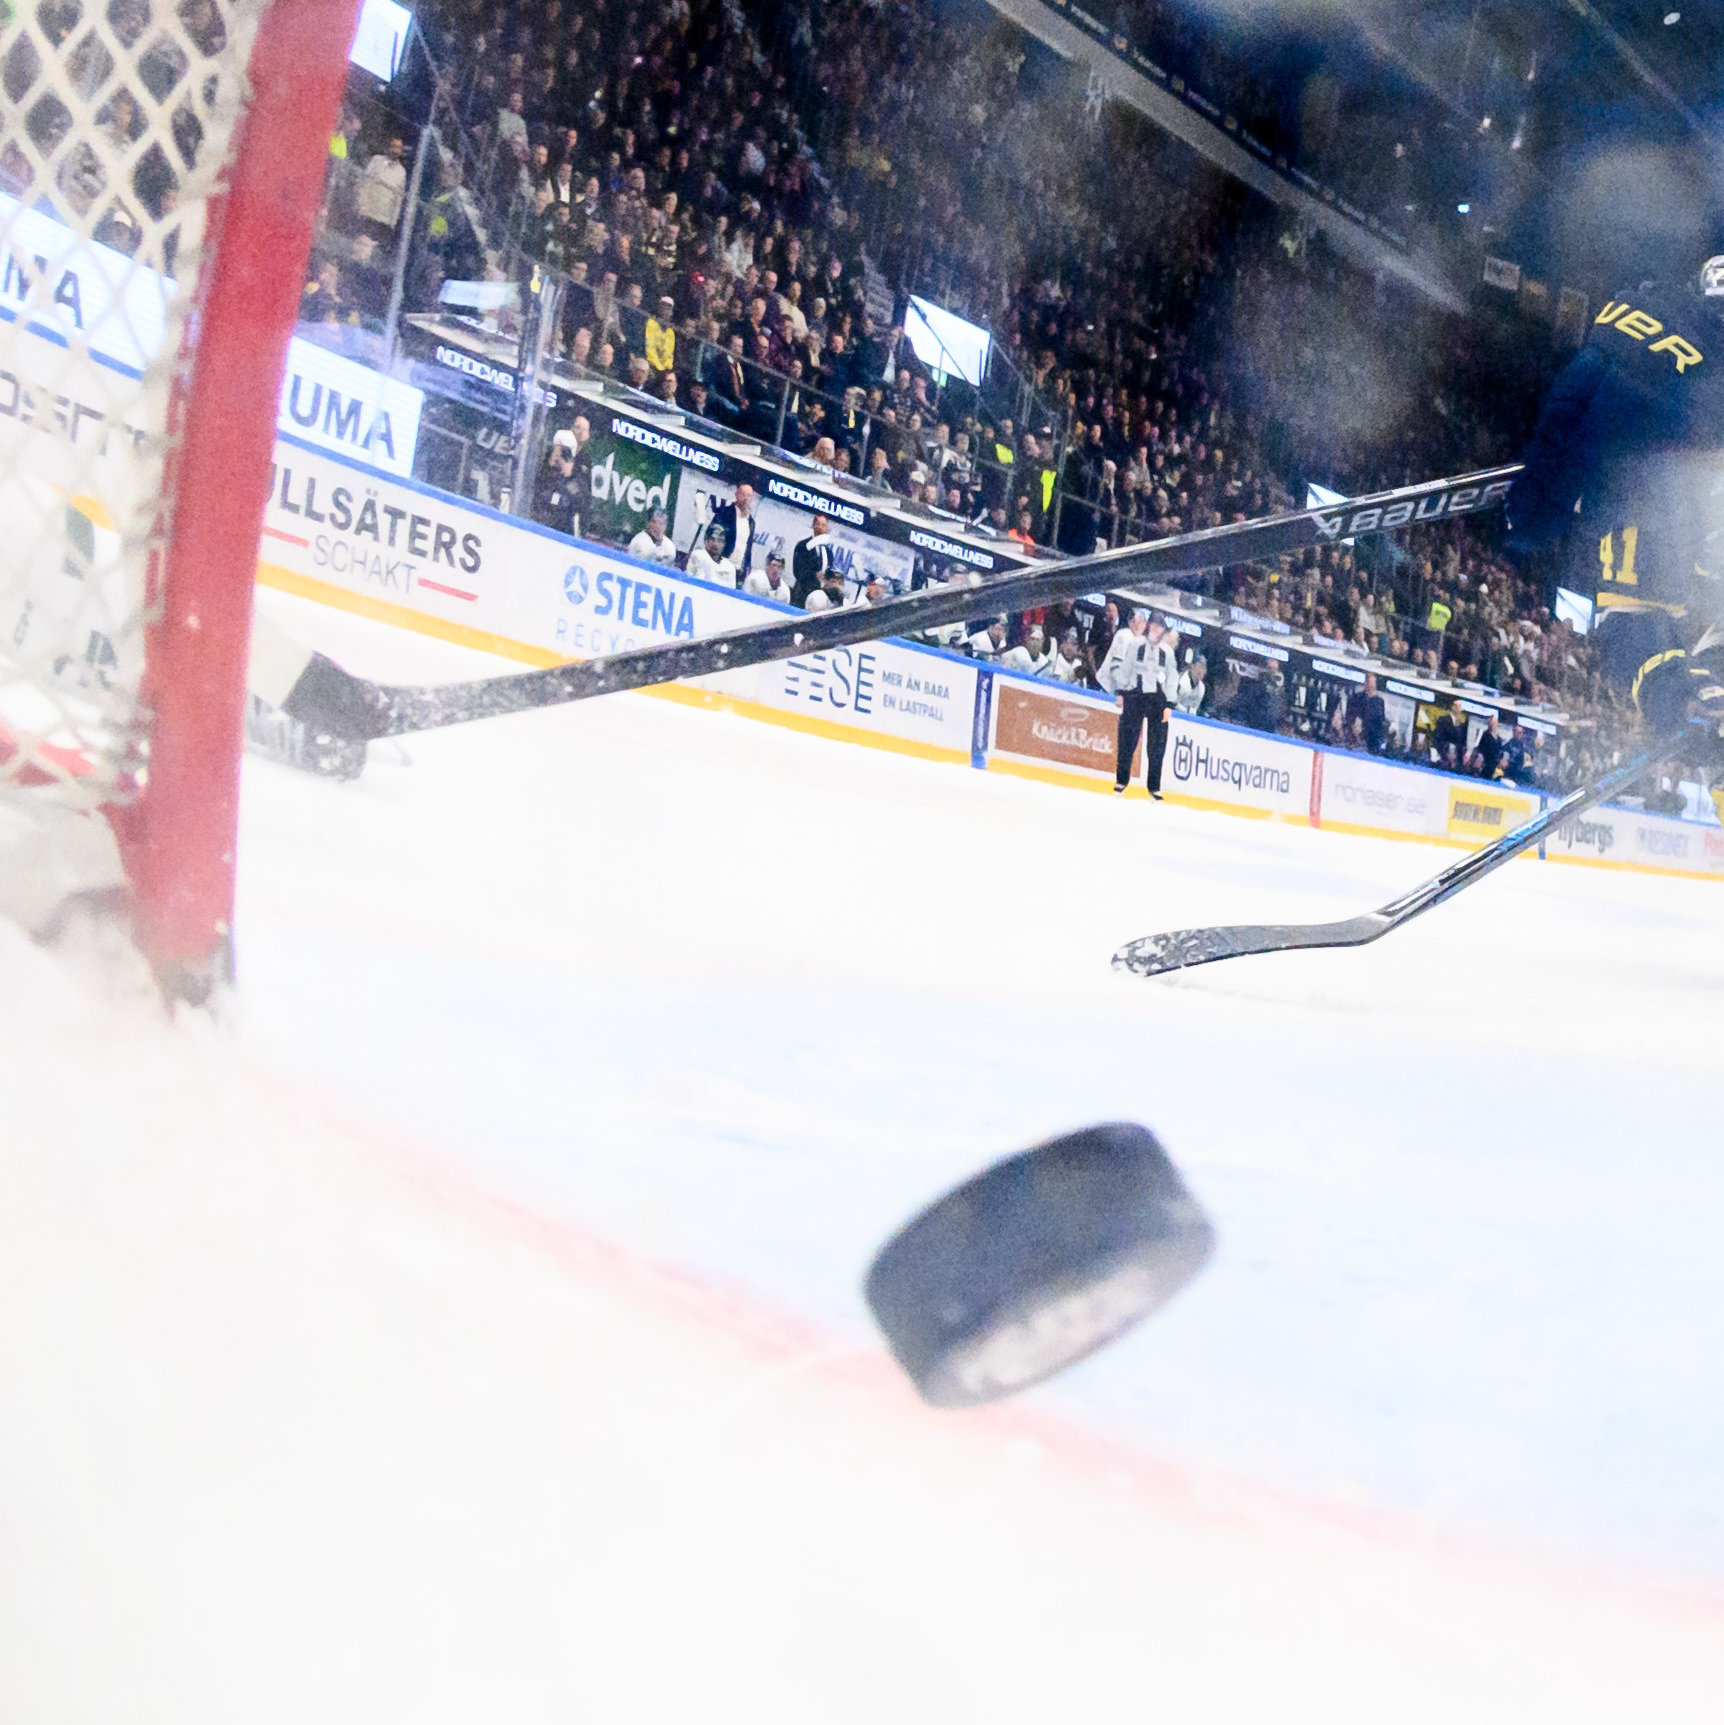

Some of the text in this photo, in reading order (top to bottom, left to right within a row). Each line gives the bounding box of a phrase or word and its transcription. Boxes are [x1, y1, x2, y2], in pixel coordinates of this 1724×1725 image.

[312, 534, 417, 593] SCHAKT
[593, 572, 696, 639] STENA
[1194, 744, 1291, 794] Husqvarna
